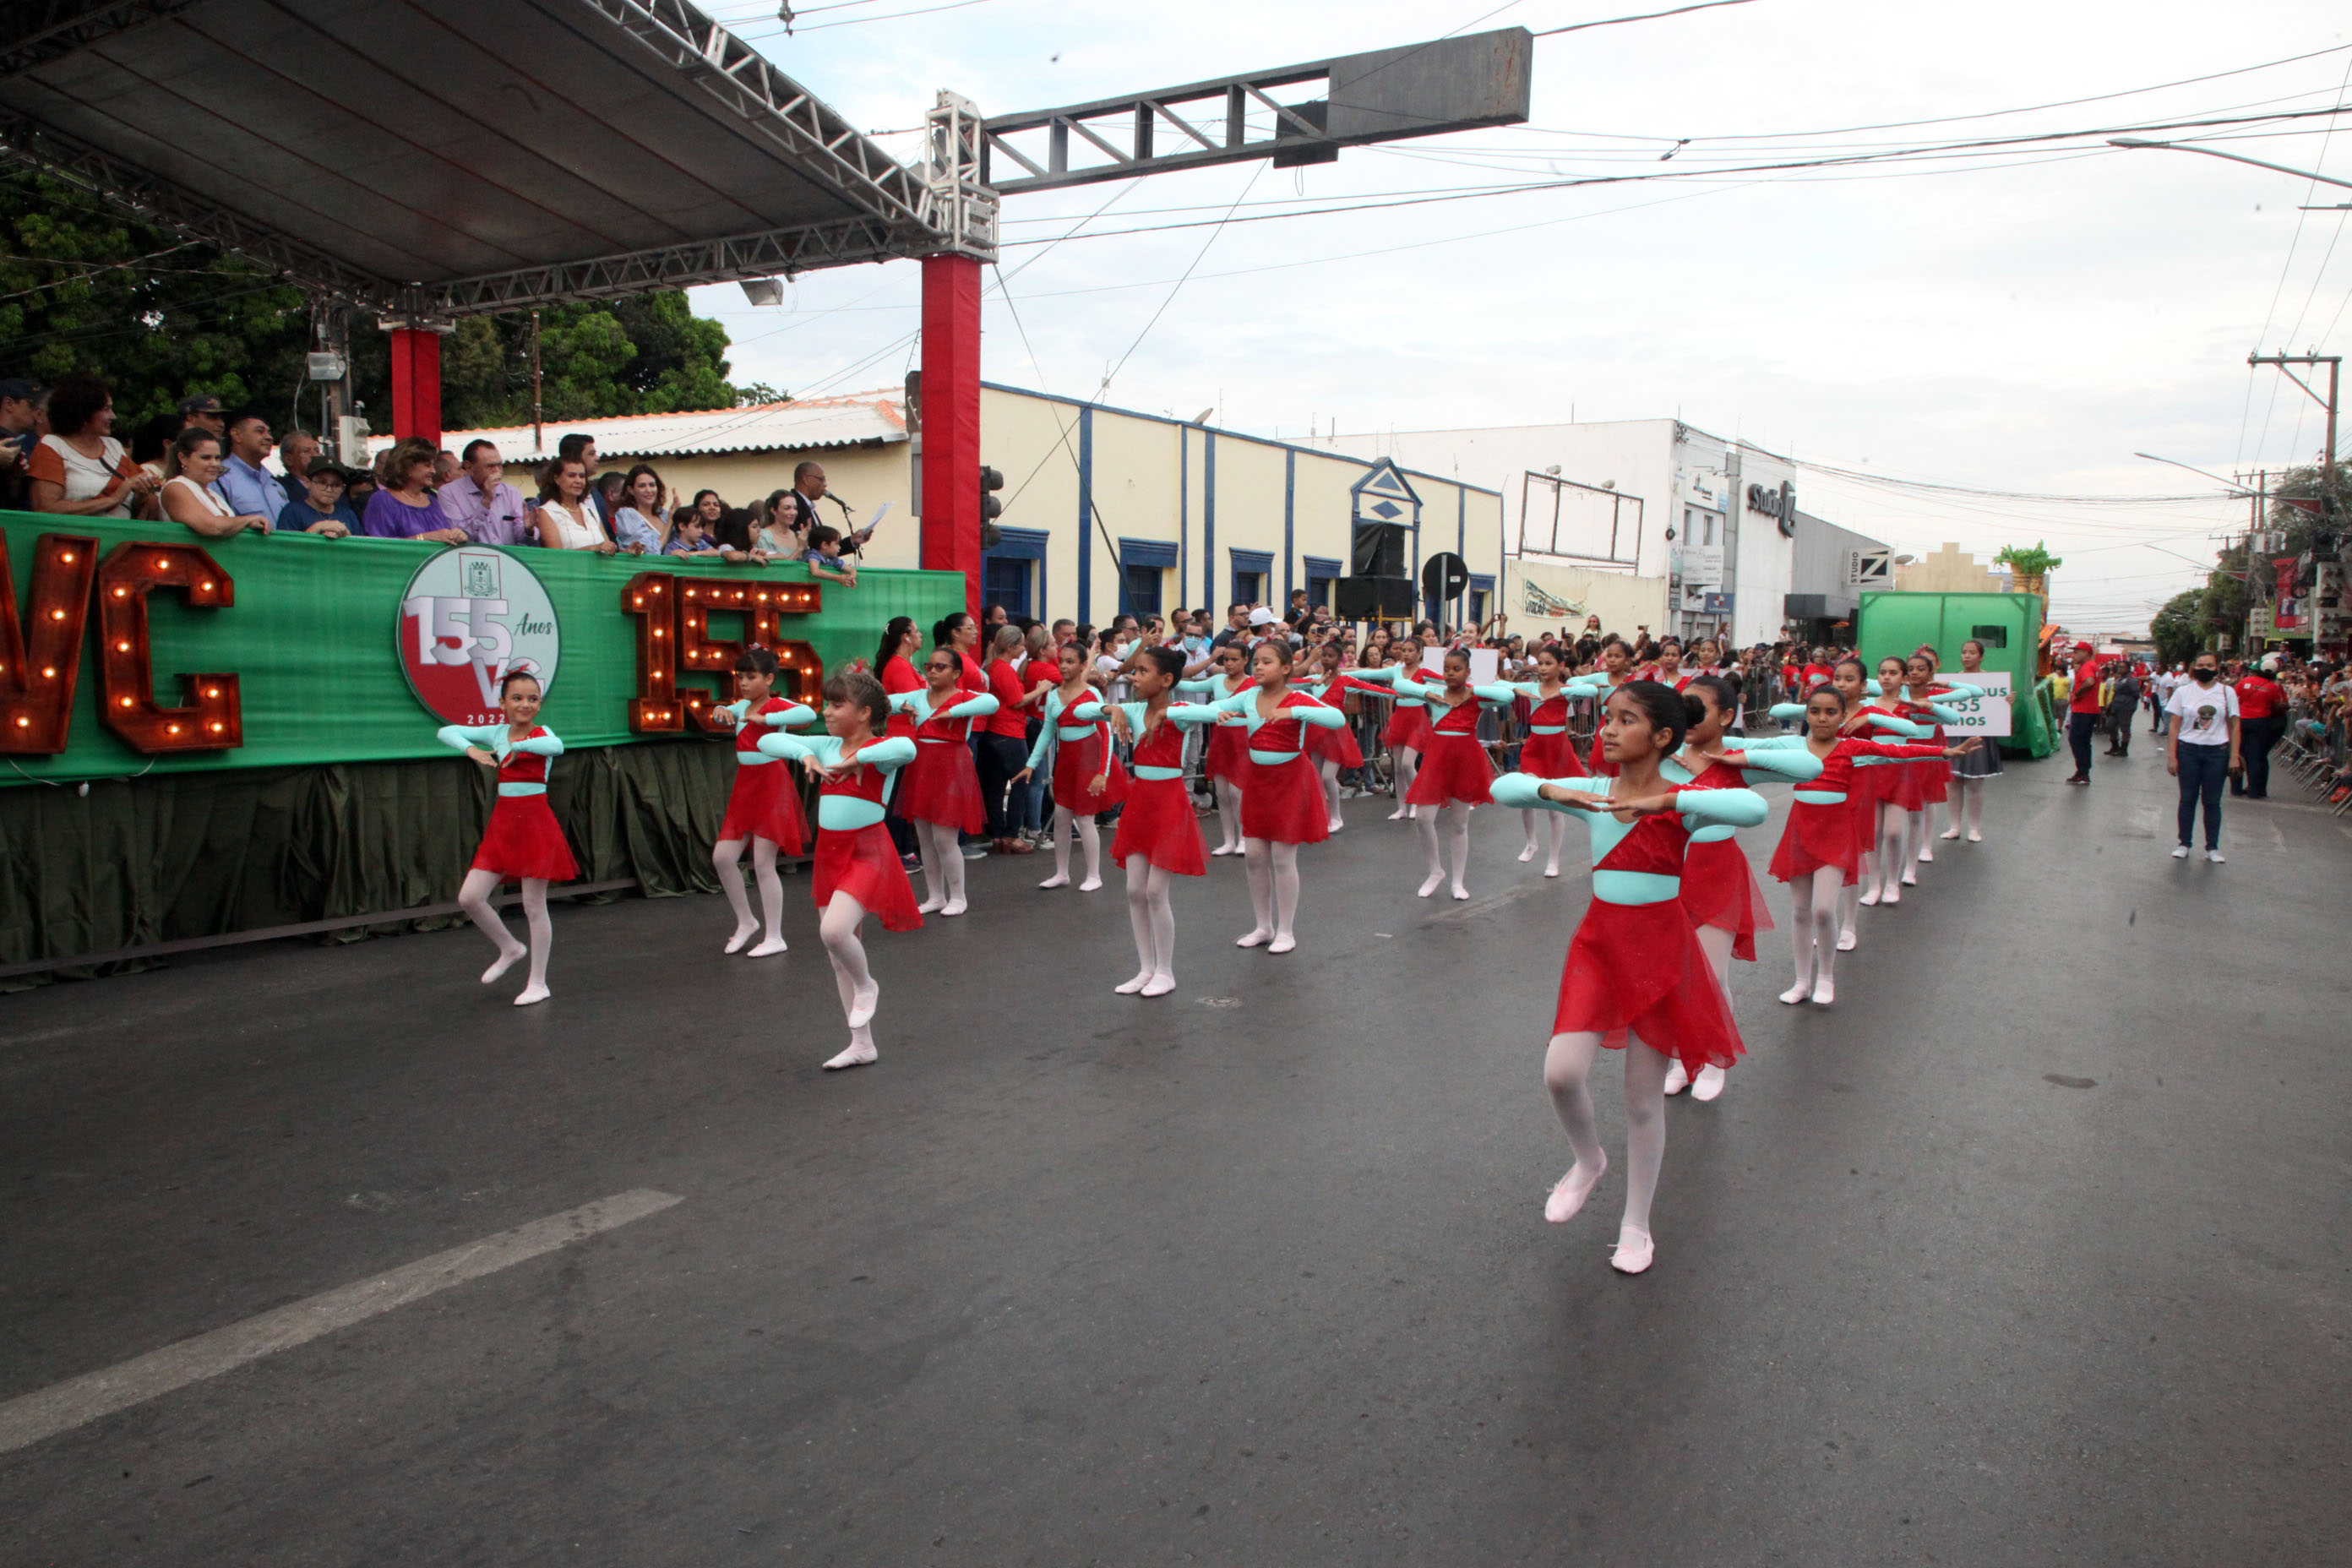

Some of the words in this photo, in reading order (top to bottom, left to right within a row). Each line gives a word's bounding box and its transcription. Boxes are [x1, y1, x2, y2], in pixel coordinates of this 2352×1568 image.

[1747, 482, 1783, 517] Studio
[403, 596, 513, 667] 155
[514, 612, 553, 635] Anos
[621, 571, 823, 733] 155
[1982, 687, 2008, 697] us
[467, 715, 505, 724] 2022
[1952, 716, 1986, 727] nos
